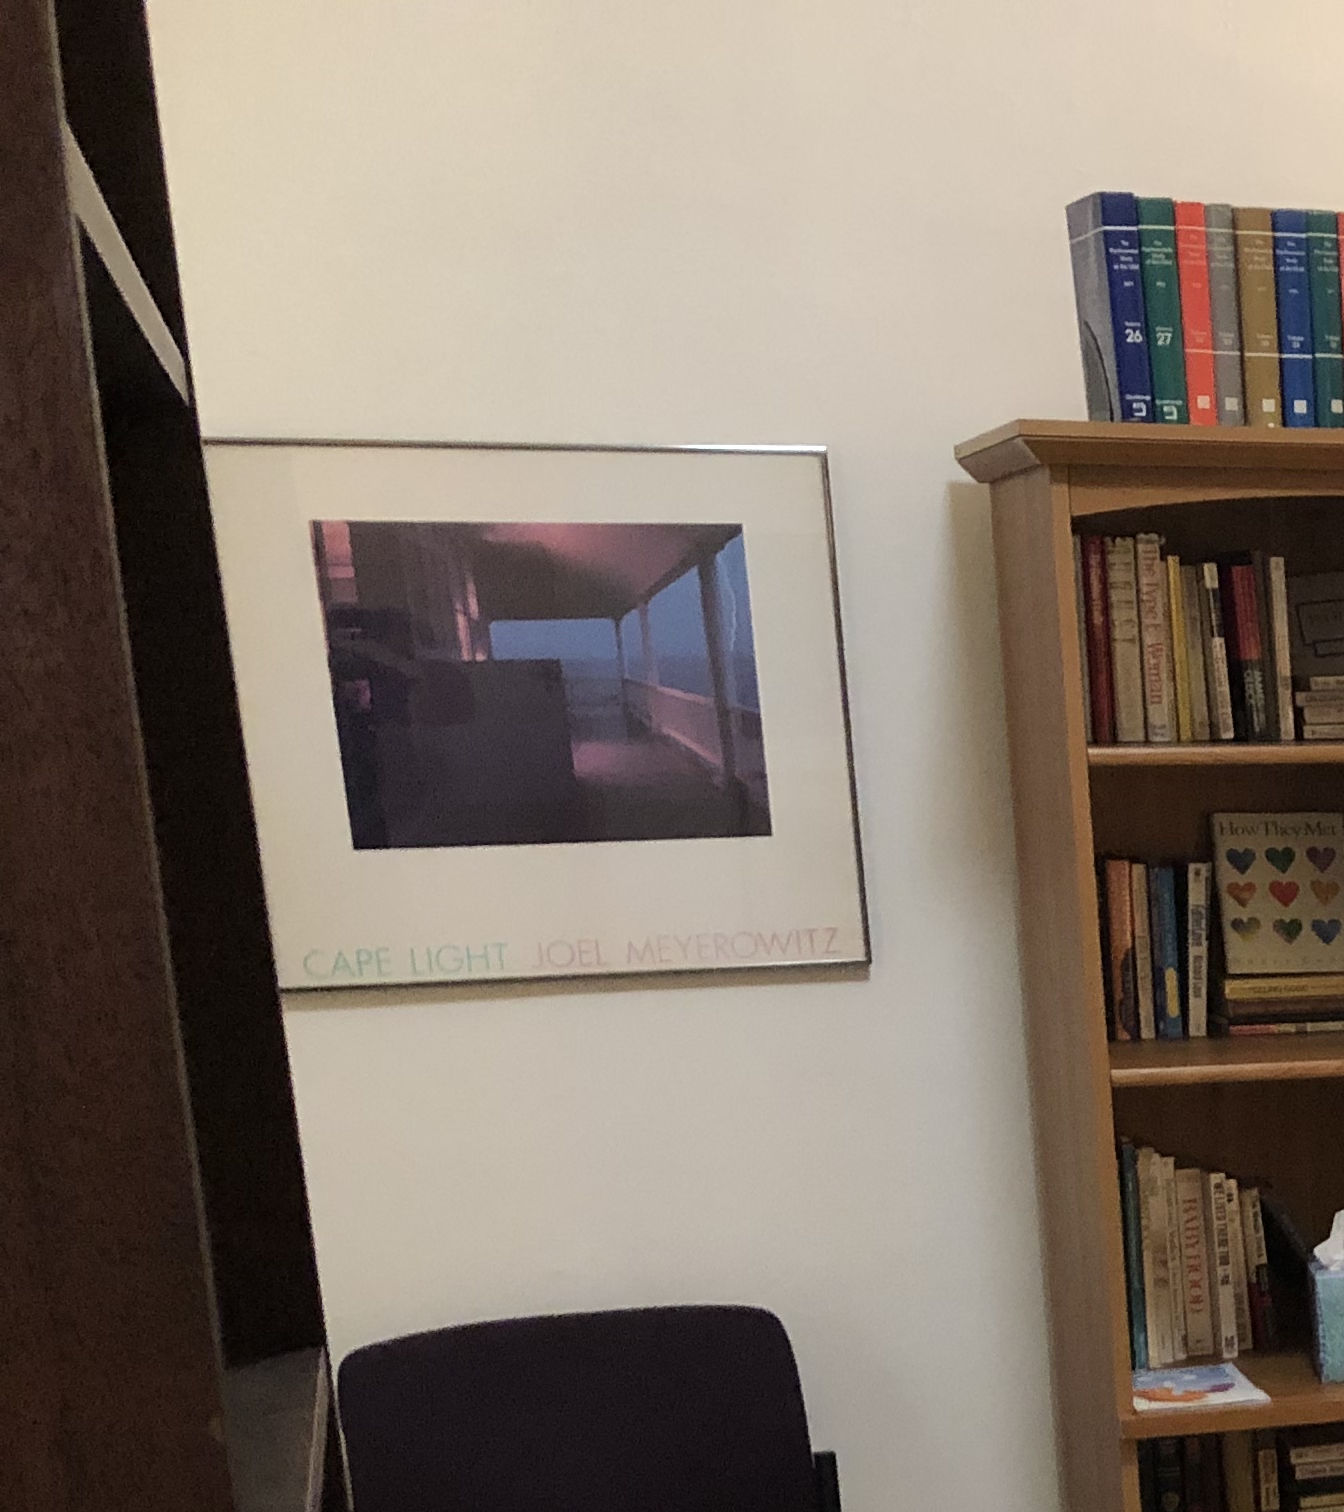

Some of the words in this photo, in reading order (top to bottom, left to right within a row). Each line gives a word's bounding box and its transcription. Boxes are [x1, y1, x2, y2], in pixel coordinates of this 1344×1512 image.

[1124, 327, 1143, 344] 26
[1155, 331, 1173, 347] 27
[1141, 581, 1160, 619] Type
[1147, 642, 1163, 705] Woman
[1219, 821, 1260, 836] How
[1262, 821, 1303, 838] They
[1304, 821, 1337, 836] Met
[303, 946, 391, 979] CAPE
[409, 941, 510, 976] LIGHT
[530, 938, 606, 970] JOEL
[626, 926, 840, 966] MEYEROWITZ
[1184, 1197, 1204, 1314] BABYHOOD
